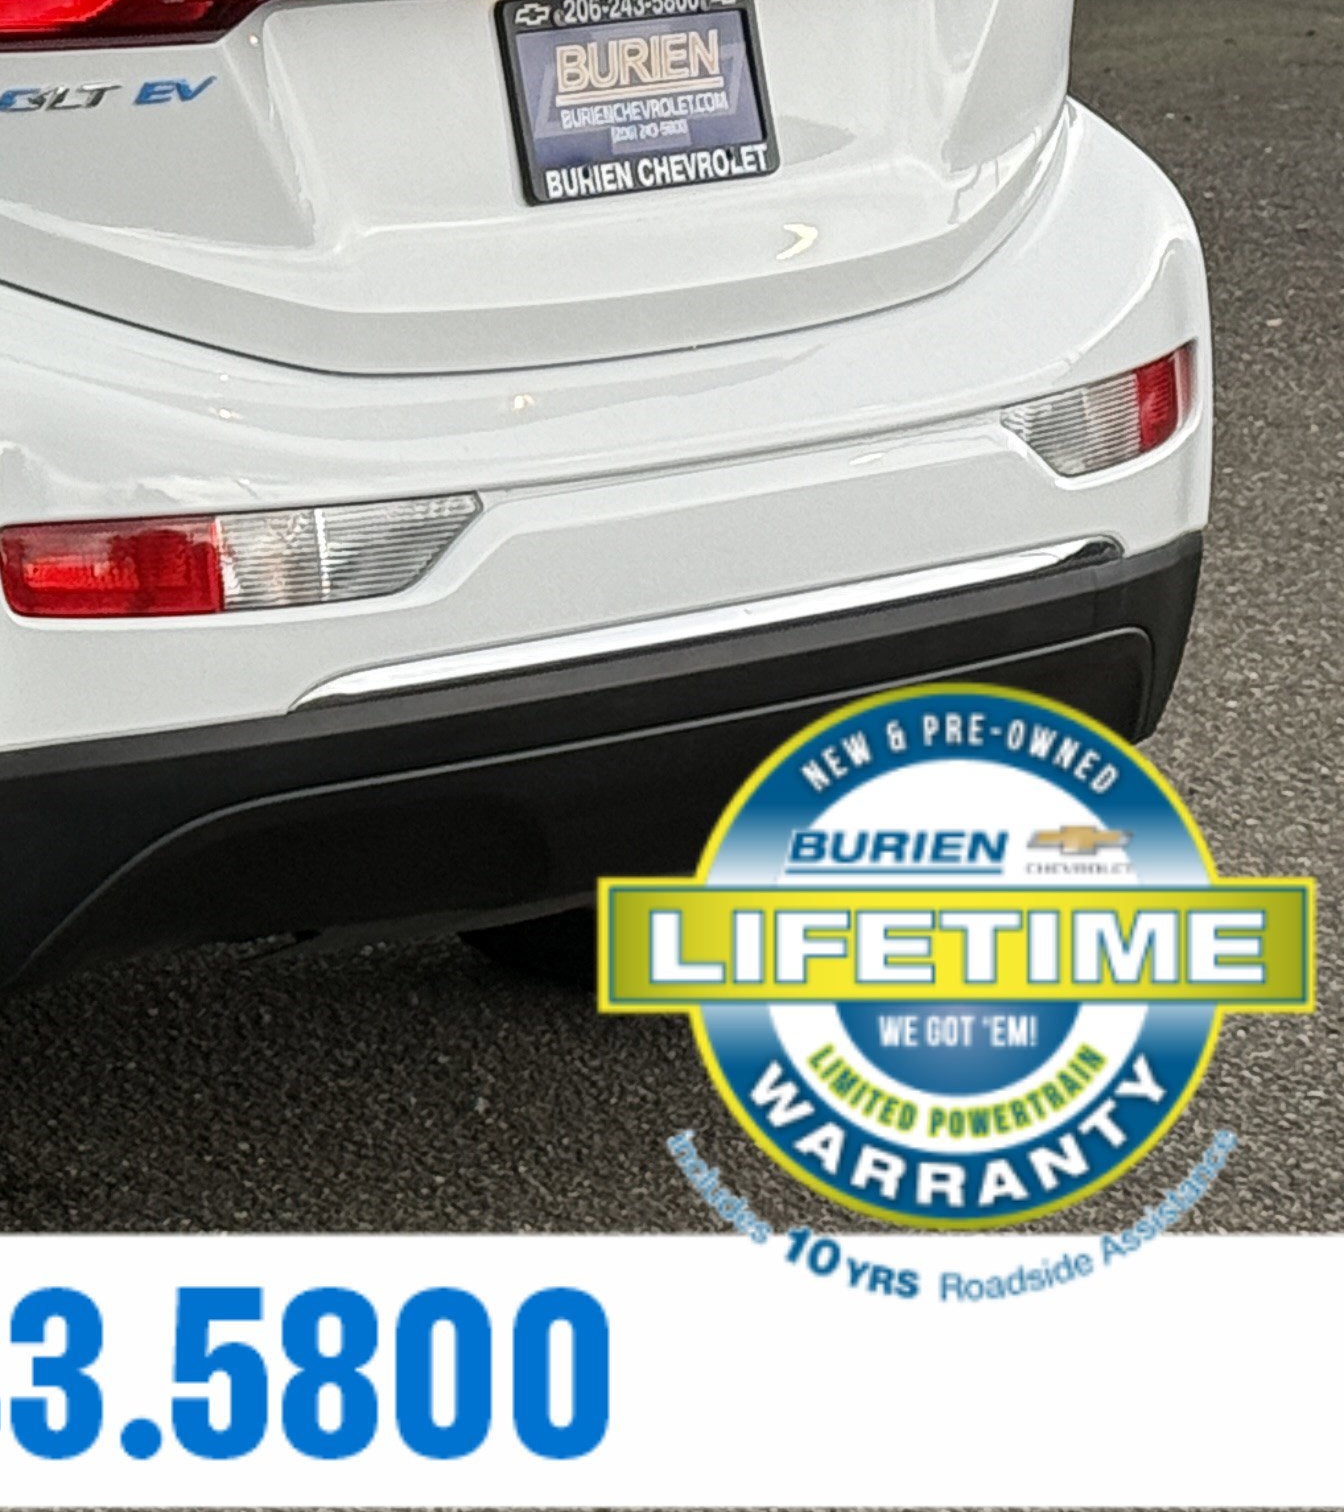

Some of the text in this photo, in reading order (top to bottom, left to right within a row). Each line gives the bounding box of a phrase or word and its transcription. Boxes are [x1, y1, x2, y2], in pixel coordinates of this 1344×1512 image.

[555, 30, 719, 92] BURIEN
[131, 75, 217, 105] EV
[560, 91, 730, 129] BURIENCHEVROLET.COM
[637, 143, 768, 188] CHEVROLET
